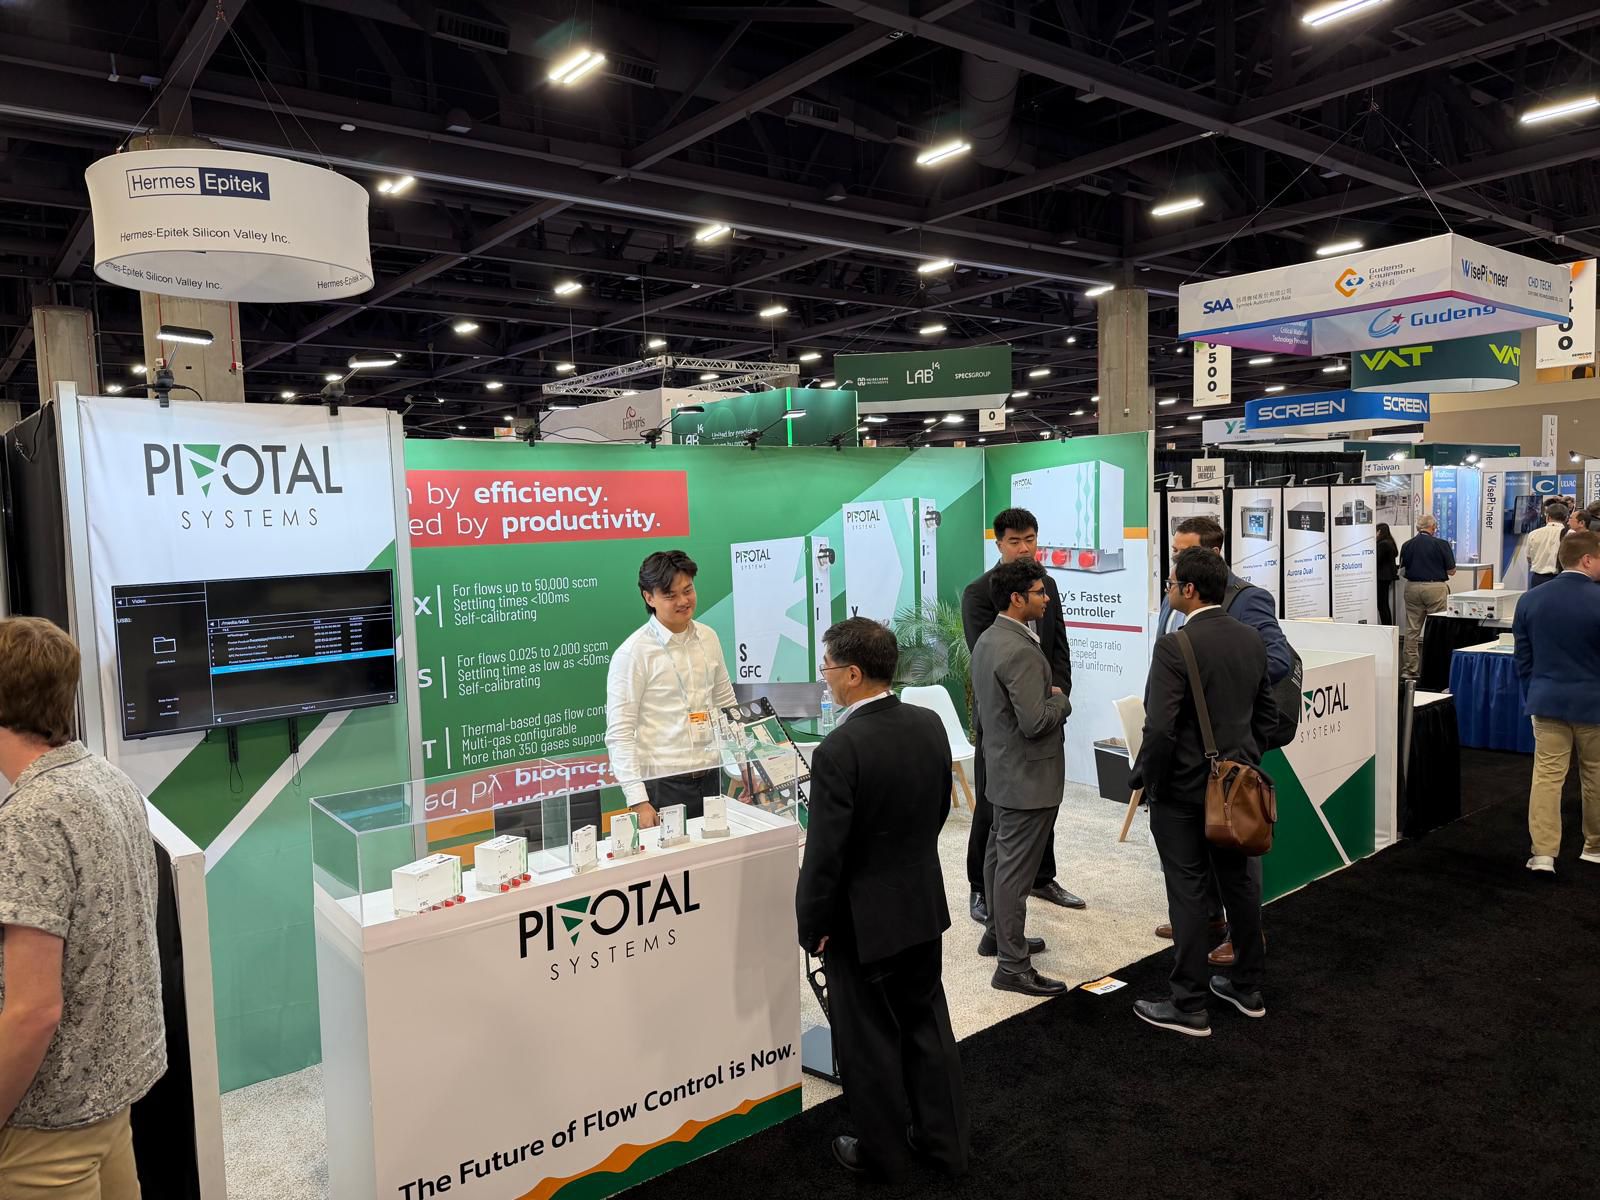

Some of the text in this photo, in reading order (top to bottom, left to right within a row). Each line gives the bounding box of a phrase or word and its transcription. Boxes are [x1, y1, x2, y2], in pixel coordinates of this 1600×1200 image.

[132, 173, 263, 194] Hermes Epitek
[120, 227, 291, 244] Hermes-Epitek Silicon Valley Inc.
[1369, 263, 1403, 274] Gudeng
[1369, 267, 1416, 280] Equipment
[145, 271, 173, 284] Silicon
[176, 275, 203, 290] Valley
[205, 280, 223, 290] Inc.
[1203, 298, 1233, 314] SAA
[1411, 304, 1496, 327] Gudeng
[1272, 335, 1293, 344] Technology
[1360, 346, 1433, 371] VAT
[1258, 398, 1345, 421] SCREEN
[1383, 396, 1428, 413] SCREEN
[144, 443, 343, 498] PIVOTAL
[427, 481, 460, 509] by
[474, 480, 608, 506] efficiency.
[181, 508, 318, 530] SYSTEMS
[409, 508, 661, 539] ed by productivity.
[847, 509, 880, 523] PIVOTAL
[735, 549, 771, 563] PIVOTAL
[1342, 562, 1363, 570] Solutions
[453, 577, 598, 597] For flows up to 50,000 sccm
[453, 592, 570, 612] Settling times <100ms
[1061, 590, 1122, 607] y's Fastest
[454, 608, 537, 627] Self-calibrating
[739, 643, 747, 662] S
[1068, 637, 1122, 651] annel gas ratio
[457, 641, 609, 668] For flows 0.025 to 2,000 sccm
[457, 654, 610, 682] Settling time as low as <50ms
[739, 665, 762, 678] GFC
[1085, 660, 1123, 674] uniformity
[458, 676, 541, 697] Self-calibrating
[461, 713, 541, 738] Thermal-based
[544, 711, 562, 727] gas
[564, 708, 584, 721] flow
[1300, 721, 1341, 743] SYSTEMS
[462, 722, 577, 753] Multi-gas configurable
[422, 739, 437, 759] T
[463, 752, 488, 766] More
[492, 746, 516, 760] than
[518, 741, 538, 756] 350
[541, 739, 570, 754] gases
[519, 870, 700, 959] PIVOTAL
[550, 929, 676, 980] SYSTEMS
[399, 1043, 796, 1200] The Future of Flow Control is Now.
